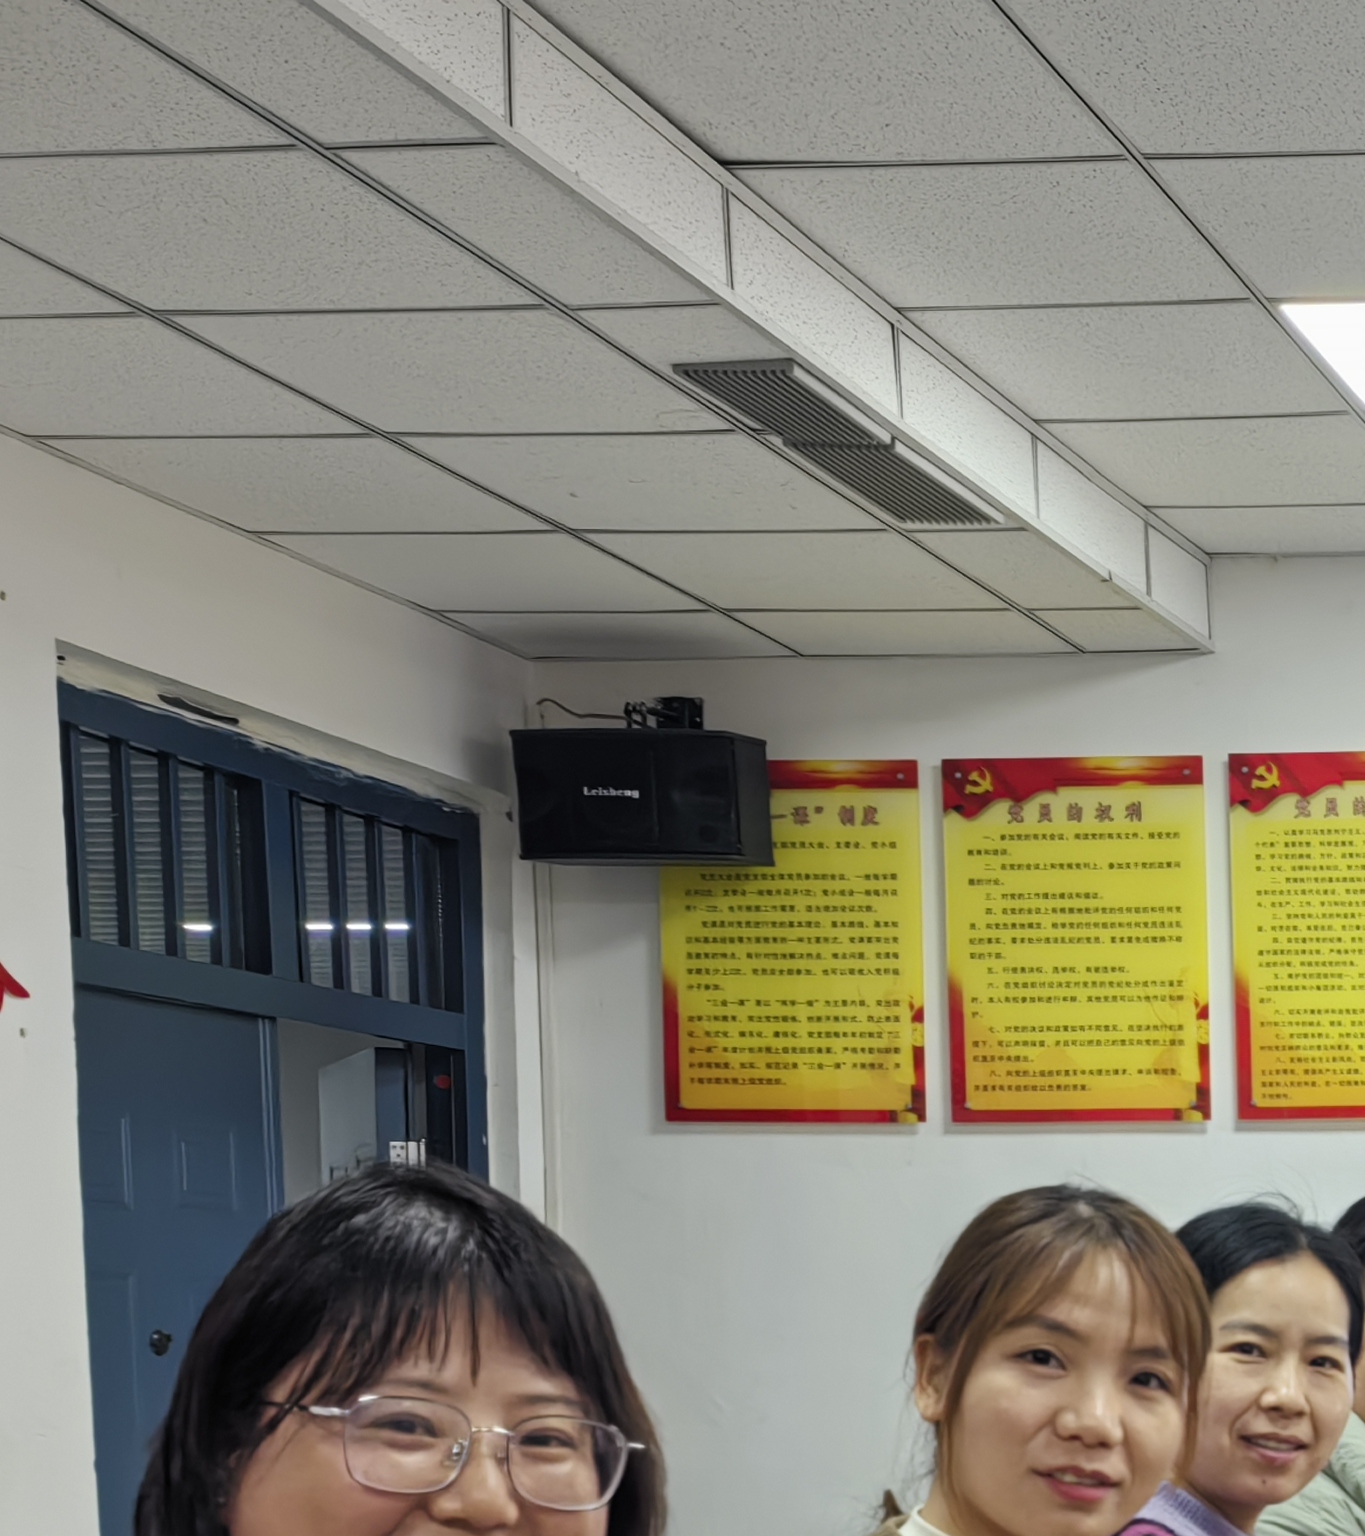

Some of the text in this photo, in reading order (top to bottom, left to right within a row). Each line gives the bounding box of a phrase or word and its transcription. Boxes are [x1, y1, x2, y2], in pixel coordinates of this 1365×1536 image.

[1007, 801, 1143, 824] 党员的权利
